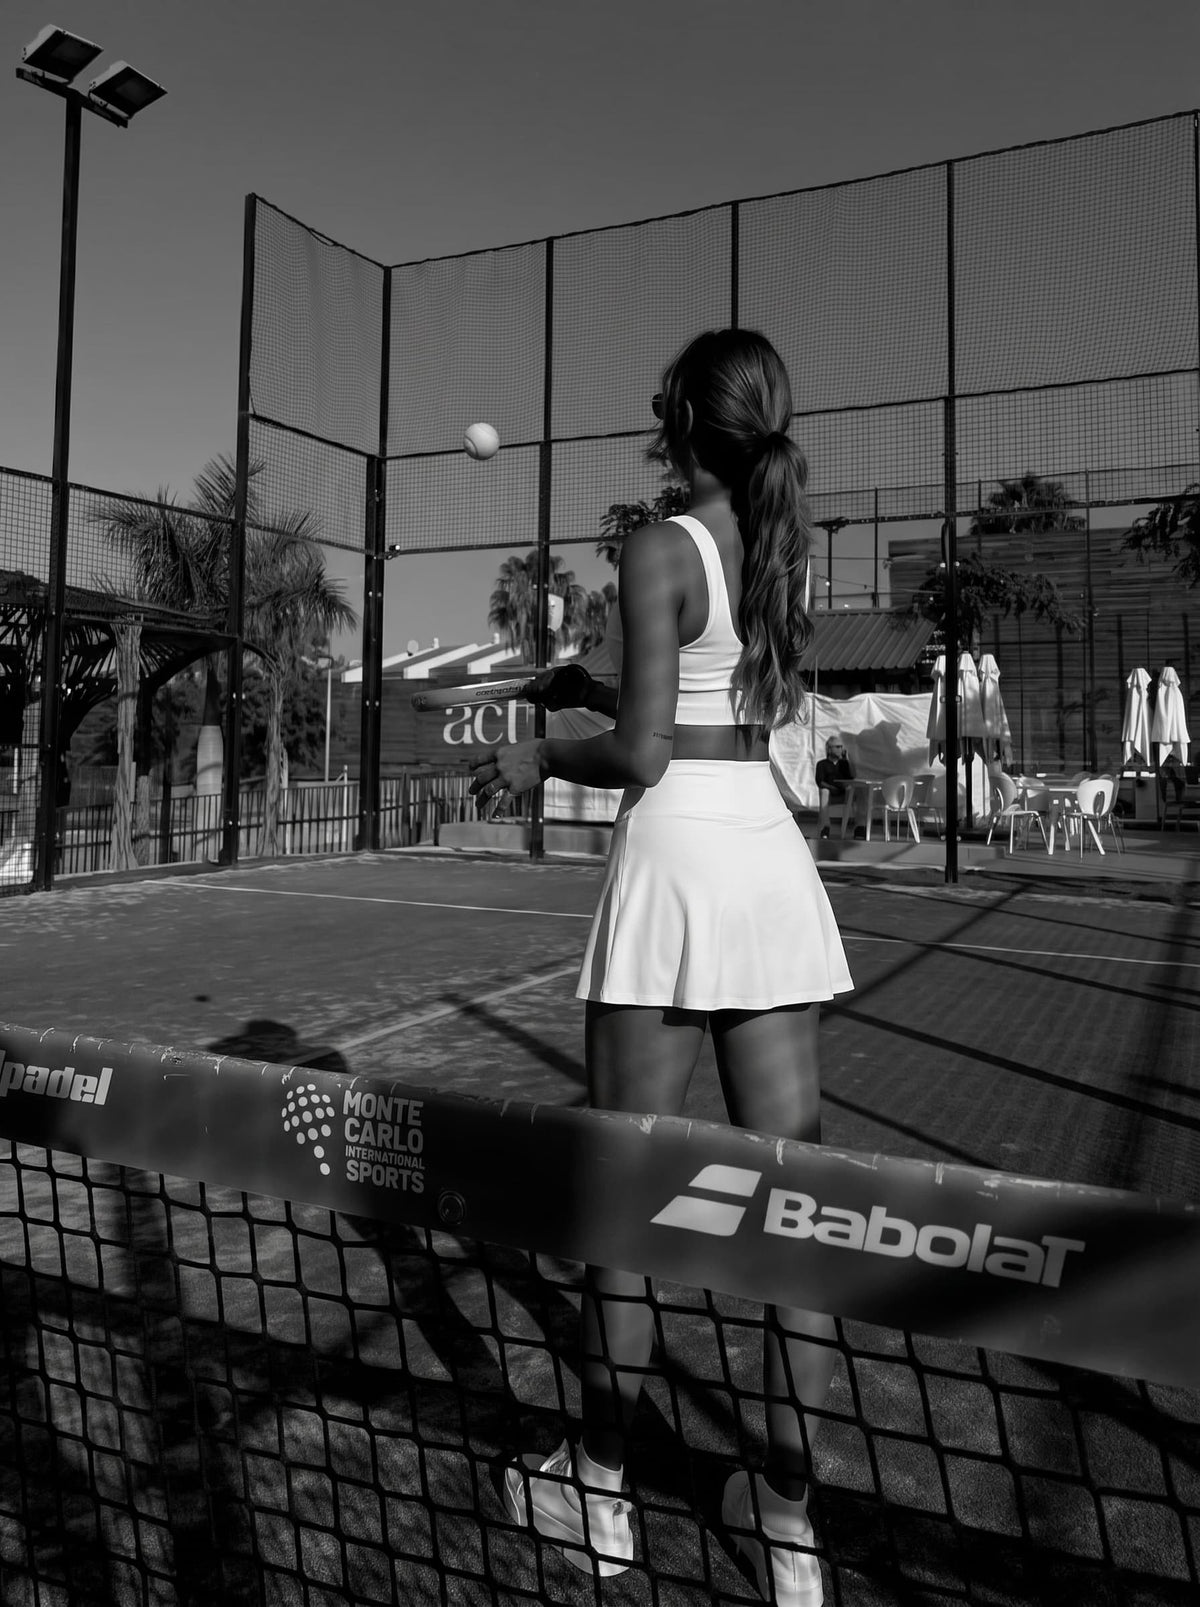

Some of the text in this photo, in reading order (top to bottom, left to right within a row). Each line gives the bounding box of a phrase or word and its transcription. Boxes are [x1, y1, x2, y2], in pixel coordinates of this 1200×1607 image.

[343, 1090, 424, 1126] MONTE
[344, 1117, 424, 1153] CARLO
[345, 1145, 426, 1170] INTERNATIONAL
[346, 1160, 425, 1194] SPORTS
